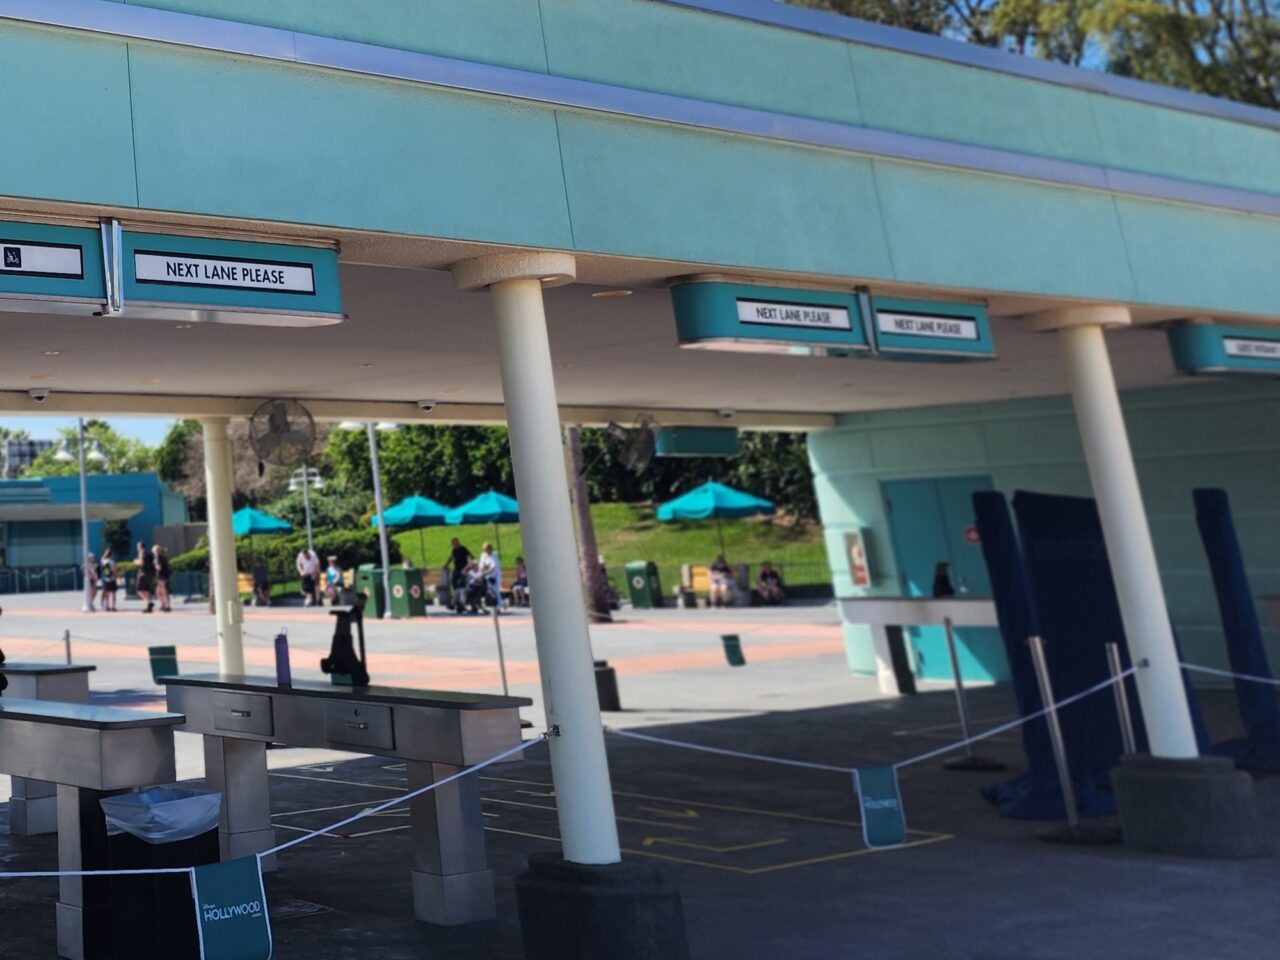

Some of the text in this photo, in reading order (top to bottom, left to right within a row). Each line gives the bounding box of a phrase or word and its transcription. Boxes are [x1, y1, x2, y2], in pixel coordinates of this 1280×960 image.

[166, 261, 285, 285] NEXT LANE PLEASE
[755, 306, 832, 325] NEXT LANE PLEASE
[204, 901, 261, 922] HOLLYWOOD
